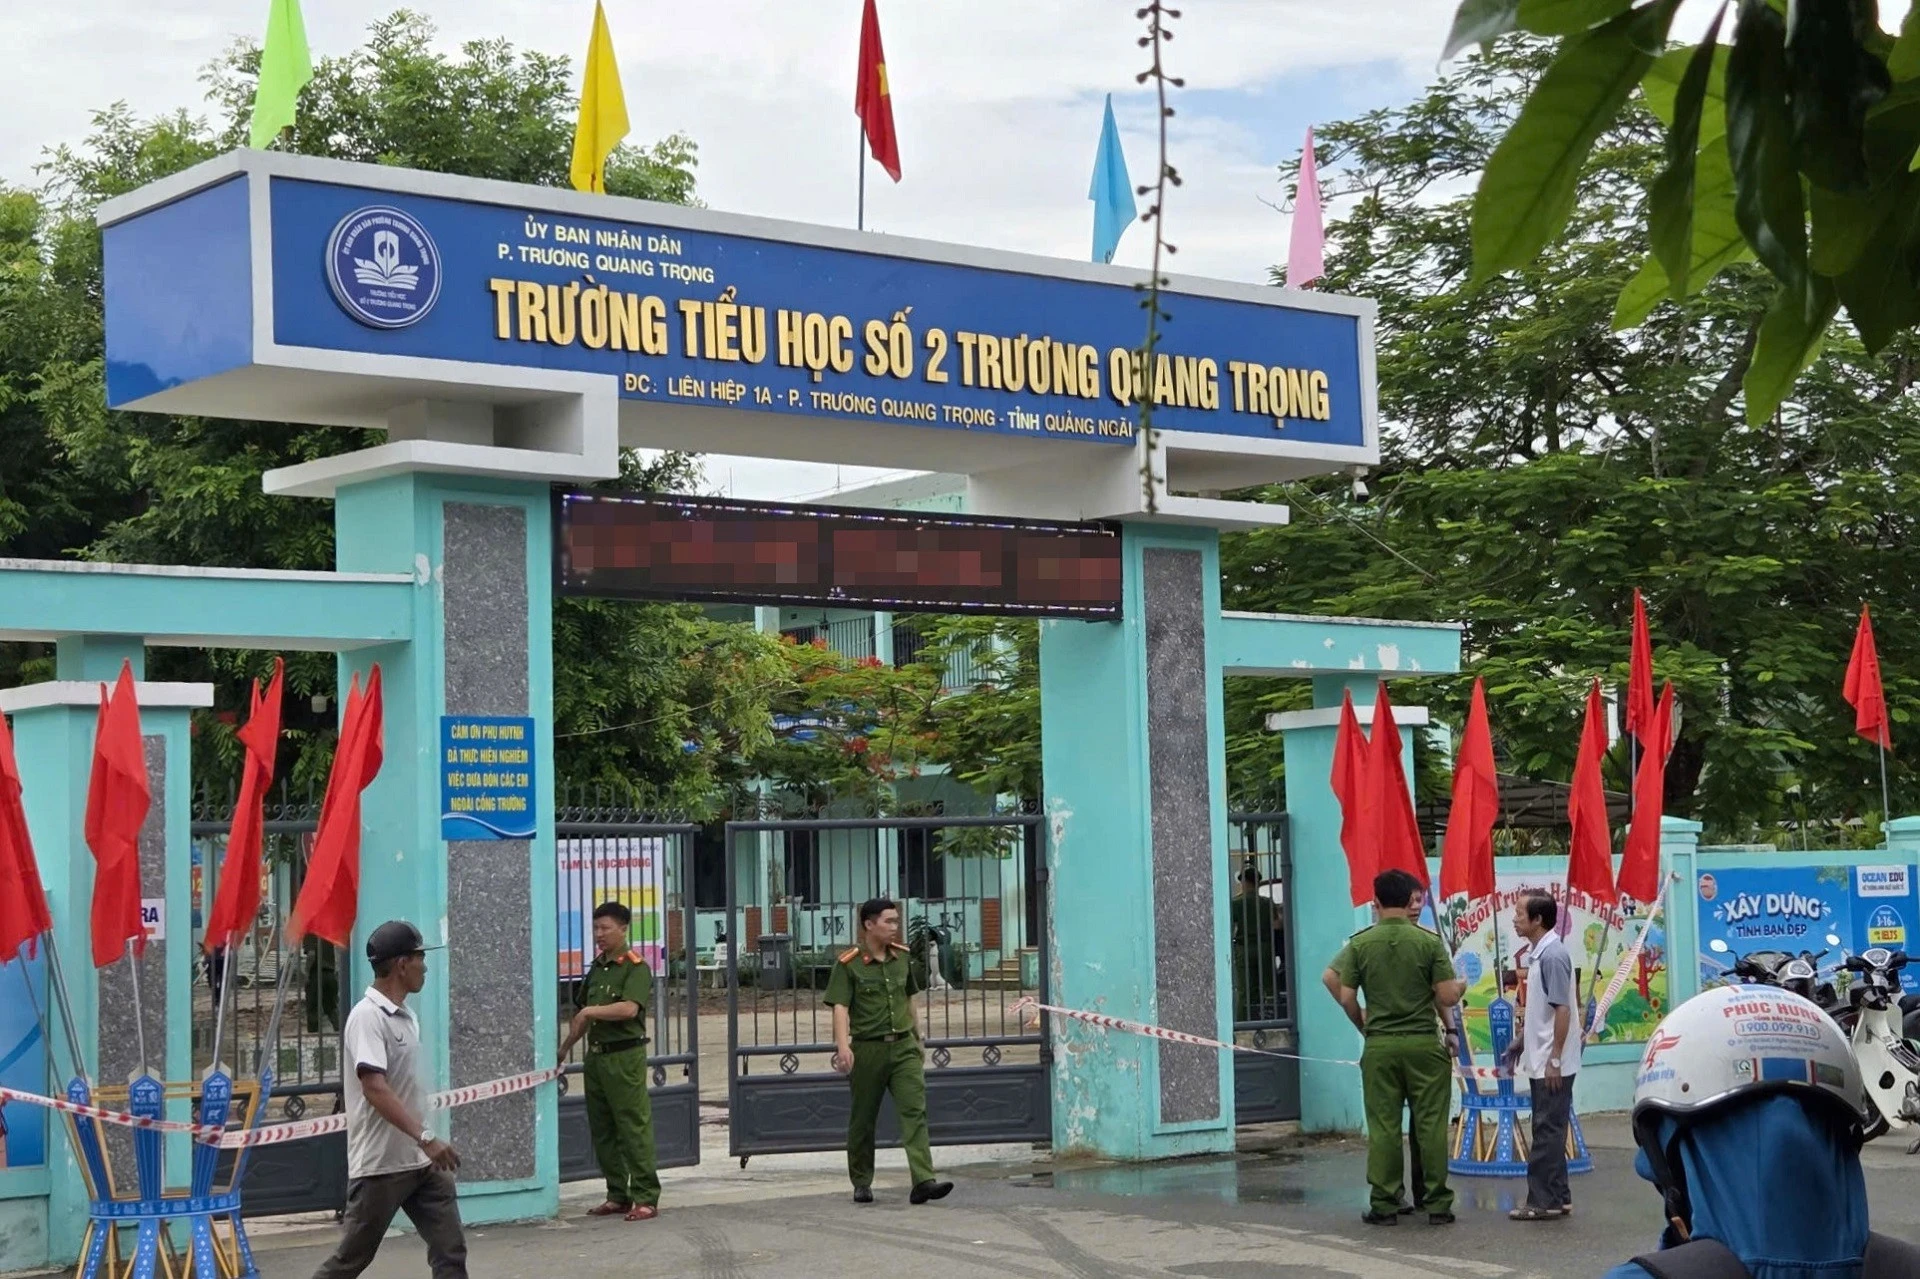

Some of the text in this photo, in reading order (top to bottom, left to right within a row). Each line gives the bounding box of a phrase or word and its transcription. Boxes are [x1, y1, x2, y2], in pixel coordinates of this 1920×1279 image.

[525, 214, 682, 256] ỦY BAN NHÂN DÂN
[498, 243, 715, 285] P. TRƯƠNG QUANG TRỌNG
[490, 274, 1330, 429] TRƯỜNG TIỂU HỌC SỐ 2 TRƯƠNG QUANG TRỌNG
[625, 373, 657, 394] ĐC:
[668, 375, 706, 398] LIÊN
[710, 379, 747, 405] HIỆP
[753, 386, 772, 405] 1A
[789, 389, 803, 407] P.
[810, 391, 877, 416] TRƯƠNG
[881, 398, 937, 421] QUANG
[942, 405, 996, 429] TRỌNG
[1007, 405, 1040, 431] TỈNH
[1045, 410, 1095, 435] QUẢNG
[1098, 416, 1133, 437] NGÃI
[482, 725, 498, 742] PHỤ
[499, 725, 524, 740] HUYNH
[1889, 872, 1904, 882] EDU
[1724, 891, 1820, 923] XÂY DỰNG
[1763, 925, 1784, 938] BẠN
[1787, 924, 1807, 938] ĐẸP
[1741, 1022, 1816, 1036] 1900.099.915
